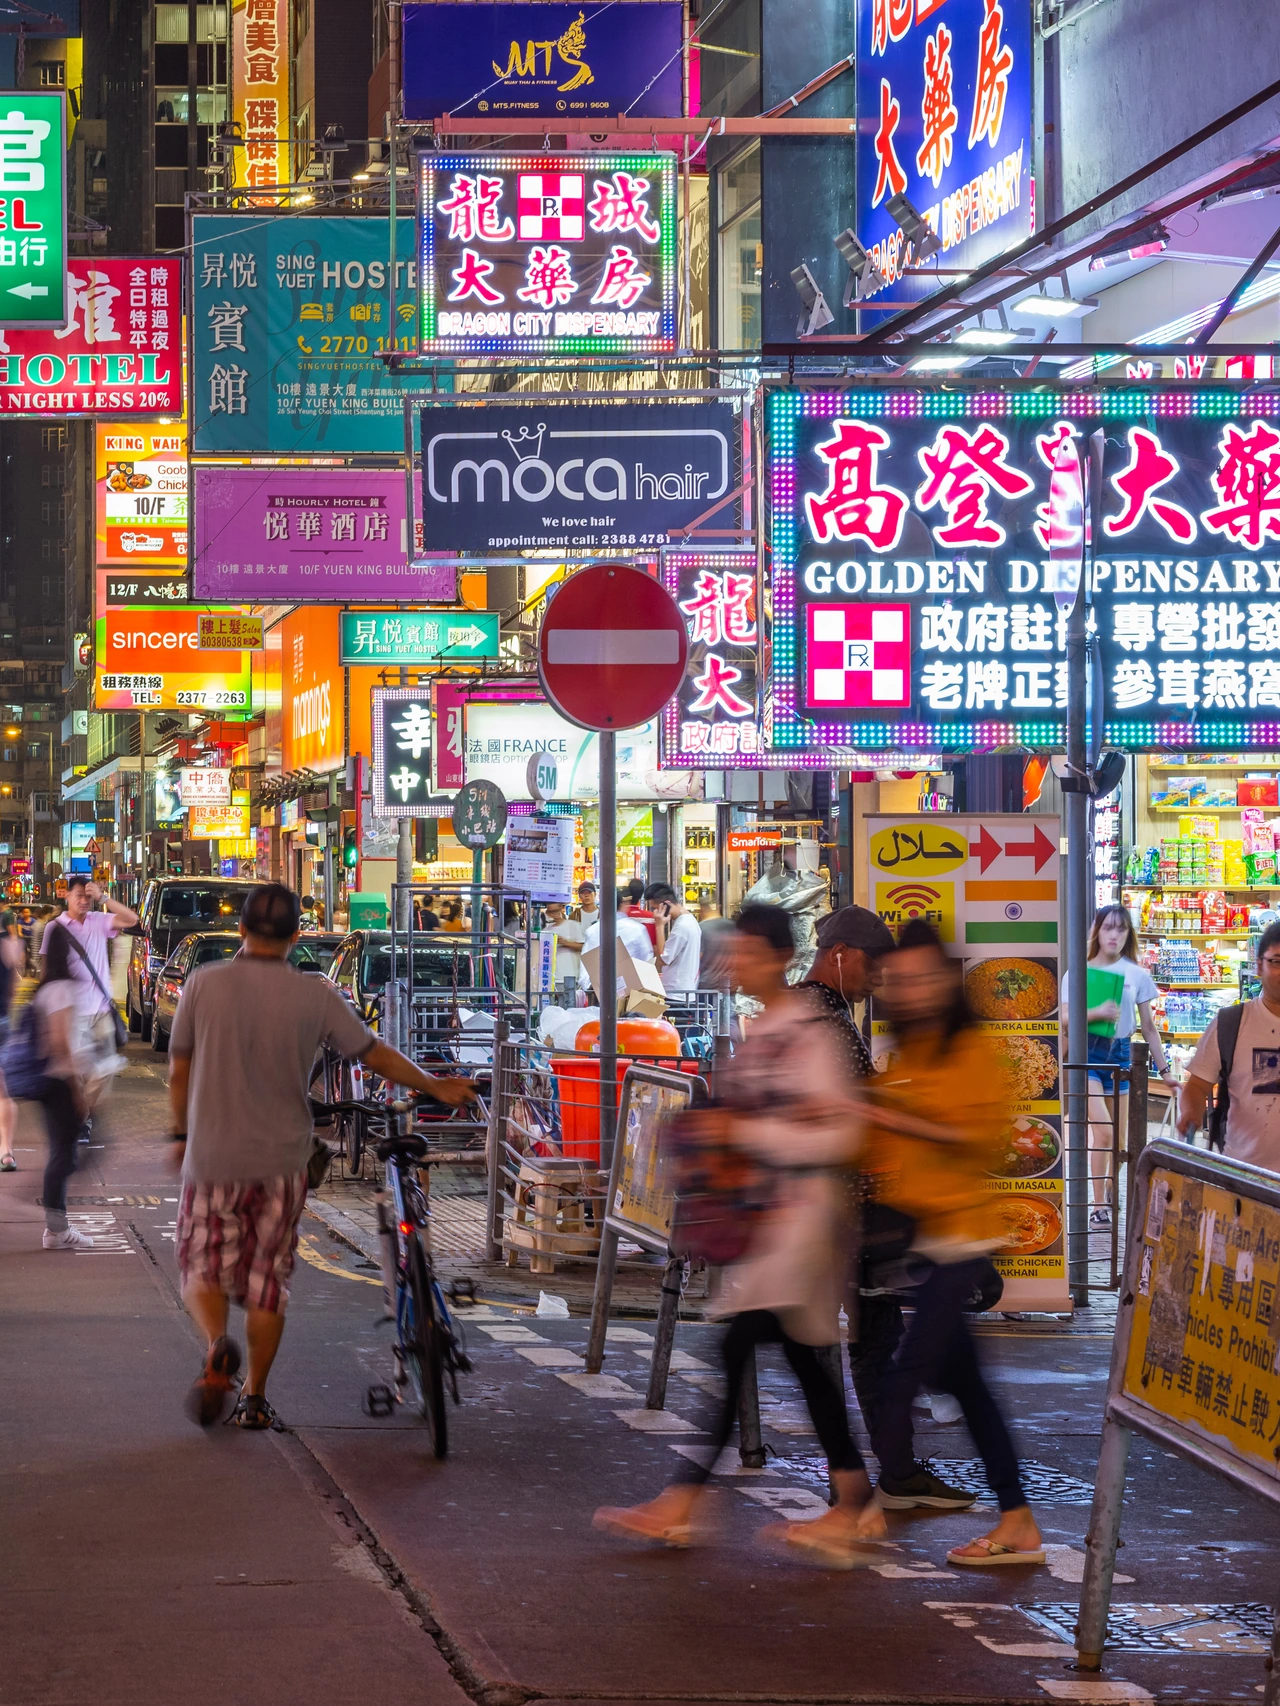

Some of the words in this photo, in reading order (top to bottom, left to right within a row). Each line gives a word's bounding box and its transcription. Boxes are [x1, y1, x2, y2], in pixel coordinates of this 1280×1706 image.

[276, 254, 316, 270] SING
[276, 273, 316, 289] YUET
[448, 245, 651, 309] 大藥房
[438, 312, 511, 336] DRAGON
[513, 312, 553, 336] CITY
[556, 311, 660, 336] DISPENSARY
[320, 336, 368, 353] 2770
[6, 392, 78, 409] NIGHT
[81, 391, 134, 409] LESS
[138, 391, 171, 408] 20%
[277, 399, 301, 408] 10/F
[306, 399, 336, 408] YUEN
[342, 399, 368, 408] KING
[106, 438, 143, 450] KING
[152, 437, 179, 450] WAH
[634, 462, 710, 501] hair
[134, 497, 165, 515] 10/F
[542, 516, 559, 527] We
[561, 515, 587, 527] love
[589, 515, 616, 527] hair
[488, 534, 569, 547] appointment
[572, 534, 599, 545] call:
[601, 533, 637, 545] 2388
[299, 565, 320, 575] 10/F
[323, 565, 352, 576] YUEN
[356, 565, 383, 576] KING
[805, 560, 985, 595] GOLDEN
[1009, 560, 1280, 594] DIPENSARY
[110, 583, 139, 596] 12/F
[113, 631, 199, 649] sincere
[201, 636, 243, 648] 60380538
[376, 645, 391, 653] SING
[395, 645, 411, 653] YUET
[414, 645, 438, 653] HOSTEL
[133, 692, 161, 704] TEL:
[178, 692, 246, 704] 2377-2263
[293, 671, 331, 746] mannings
[503, 739, 567, 752] FRANCE
[538, 766, 557, 790] 5M
[878, 830, 964, 867] حلال
[878, 910, 901, 922] Wi
[926, 910, 942, 922] Fi
[989, 1023, 1023, 1031] TARKA
[1026, 1023, 1058, 1031] LENTIL
[1015, 1181, 1056, 1190] MASALA
[1017, 1258, 1062, 1267] CHICKEN
